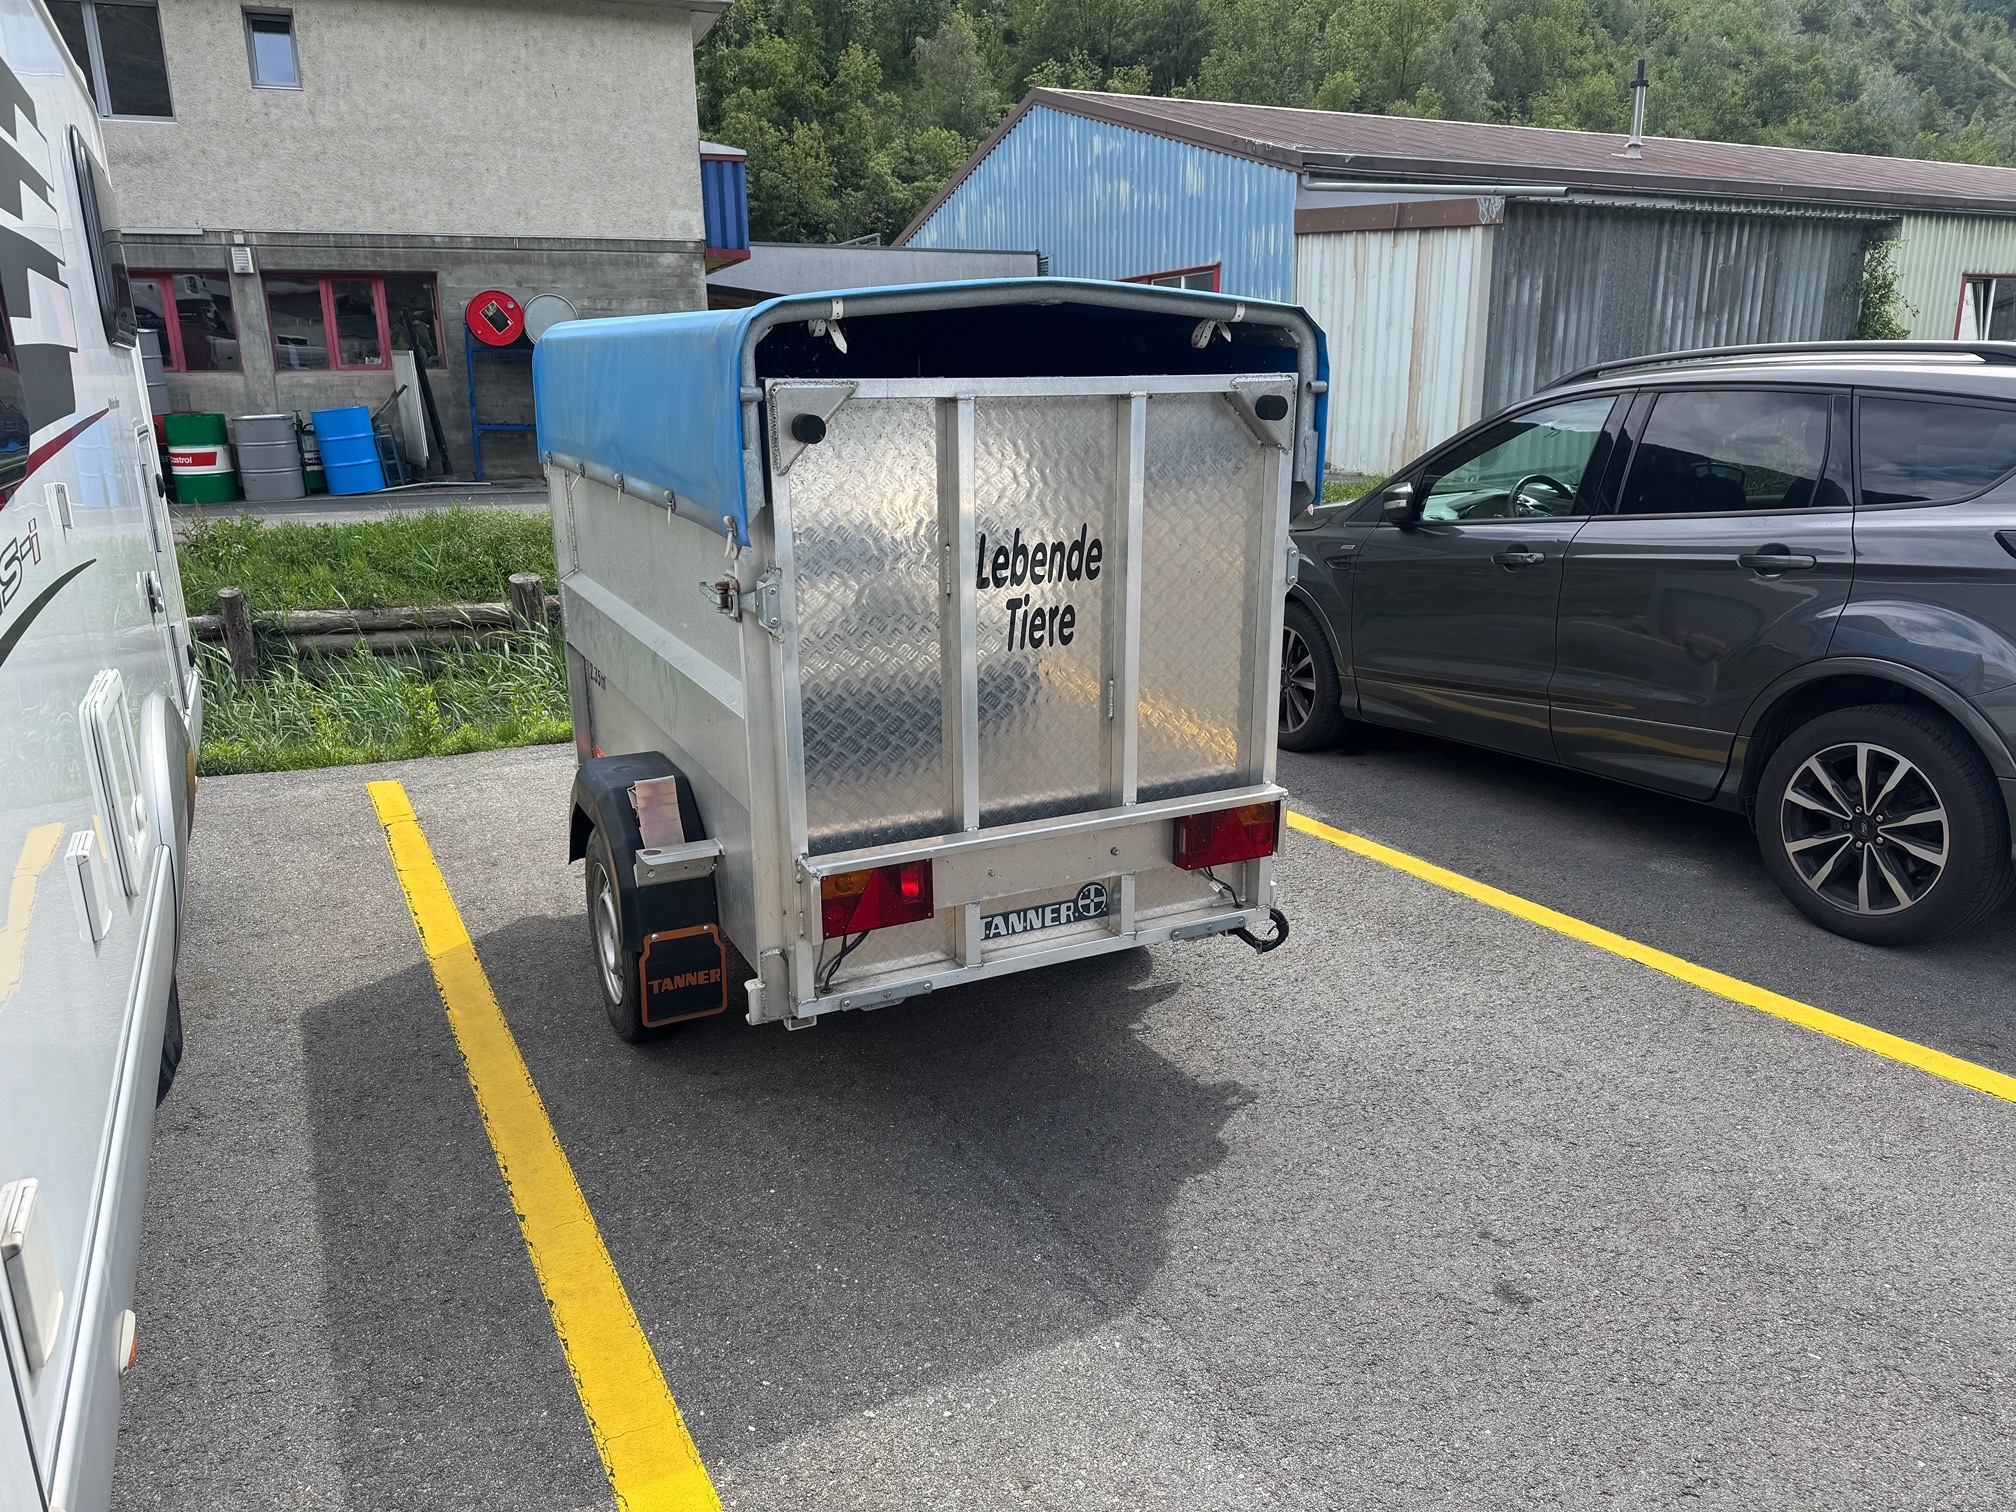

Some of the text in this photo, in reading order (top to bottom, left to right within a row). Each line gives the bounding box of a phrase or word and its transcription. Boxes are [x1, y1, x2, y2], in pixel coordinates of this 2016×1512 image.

[0, 517, 41, 615] S-i
[976, 523, 1102, 589] Lebende
[1006, 594, 1075, 651] Tiere
[980, 902, 1074, 939] TANNER
[648, 968, 720, 994] TANNER
